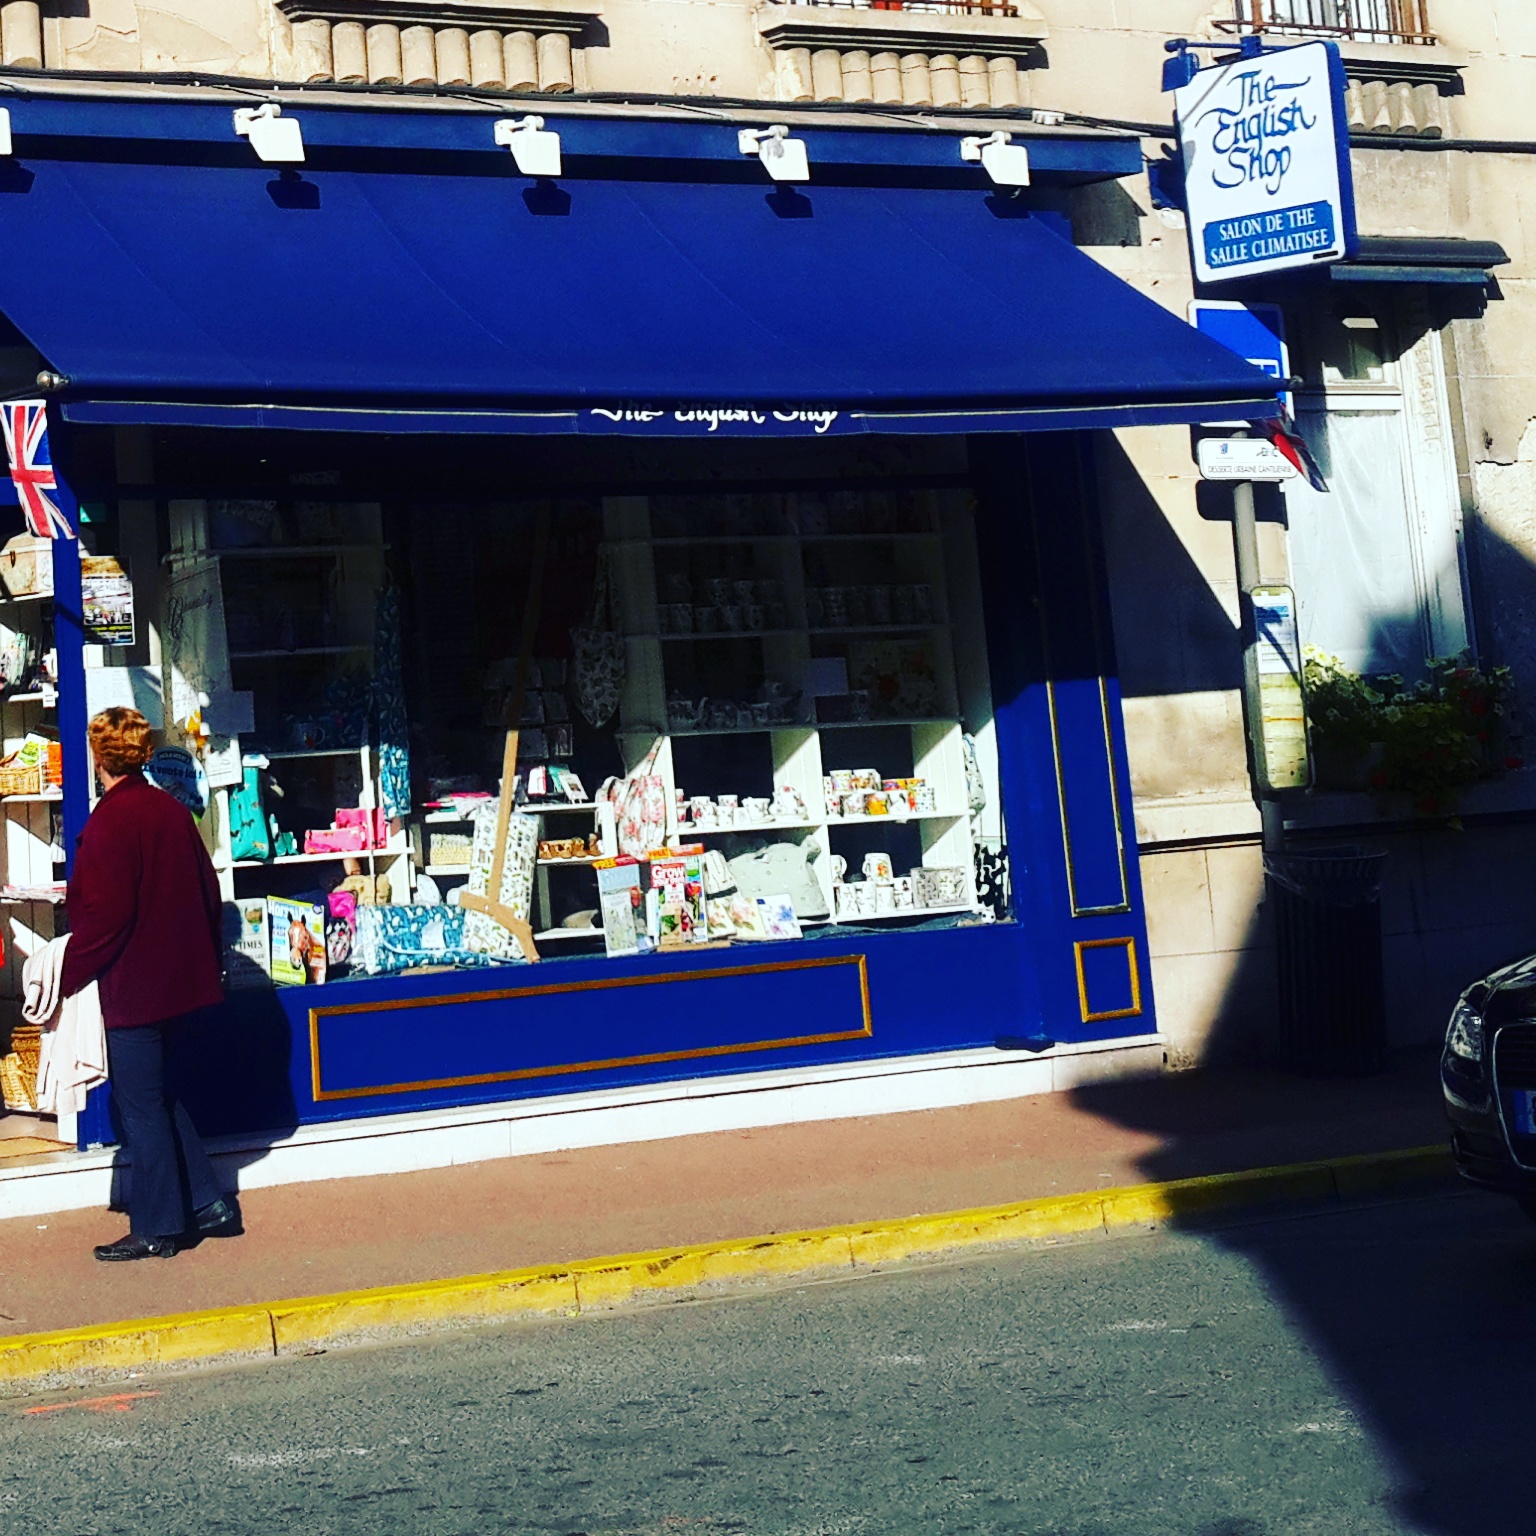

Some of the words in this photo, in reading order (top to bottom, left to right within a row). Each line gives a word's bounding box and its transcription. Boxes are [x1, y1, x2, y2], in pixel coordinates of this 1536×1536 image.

[1197, 68, 1311, 124] The
[1212, 98, 1316, 154] English
[1212, 146, 1292, 195] Shop
[1220, 218, 1263, 241] SALON
[1266, 213, 1284, 233] DE
[1287, 207, 1316, 228] THE
[1210, 244, 1248, 265] SALLE
[1252, 228, 1330, 257] CLIMATISEE
[651, 865, 684, 879] Grow
